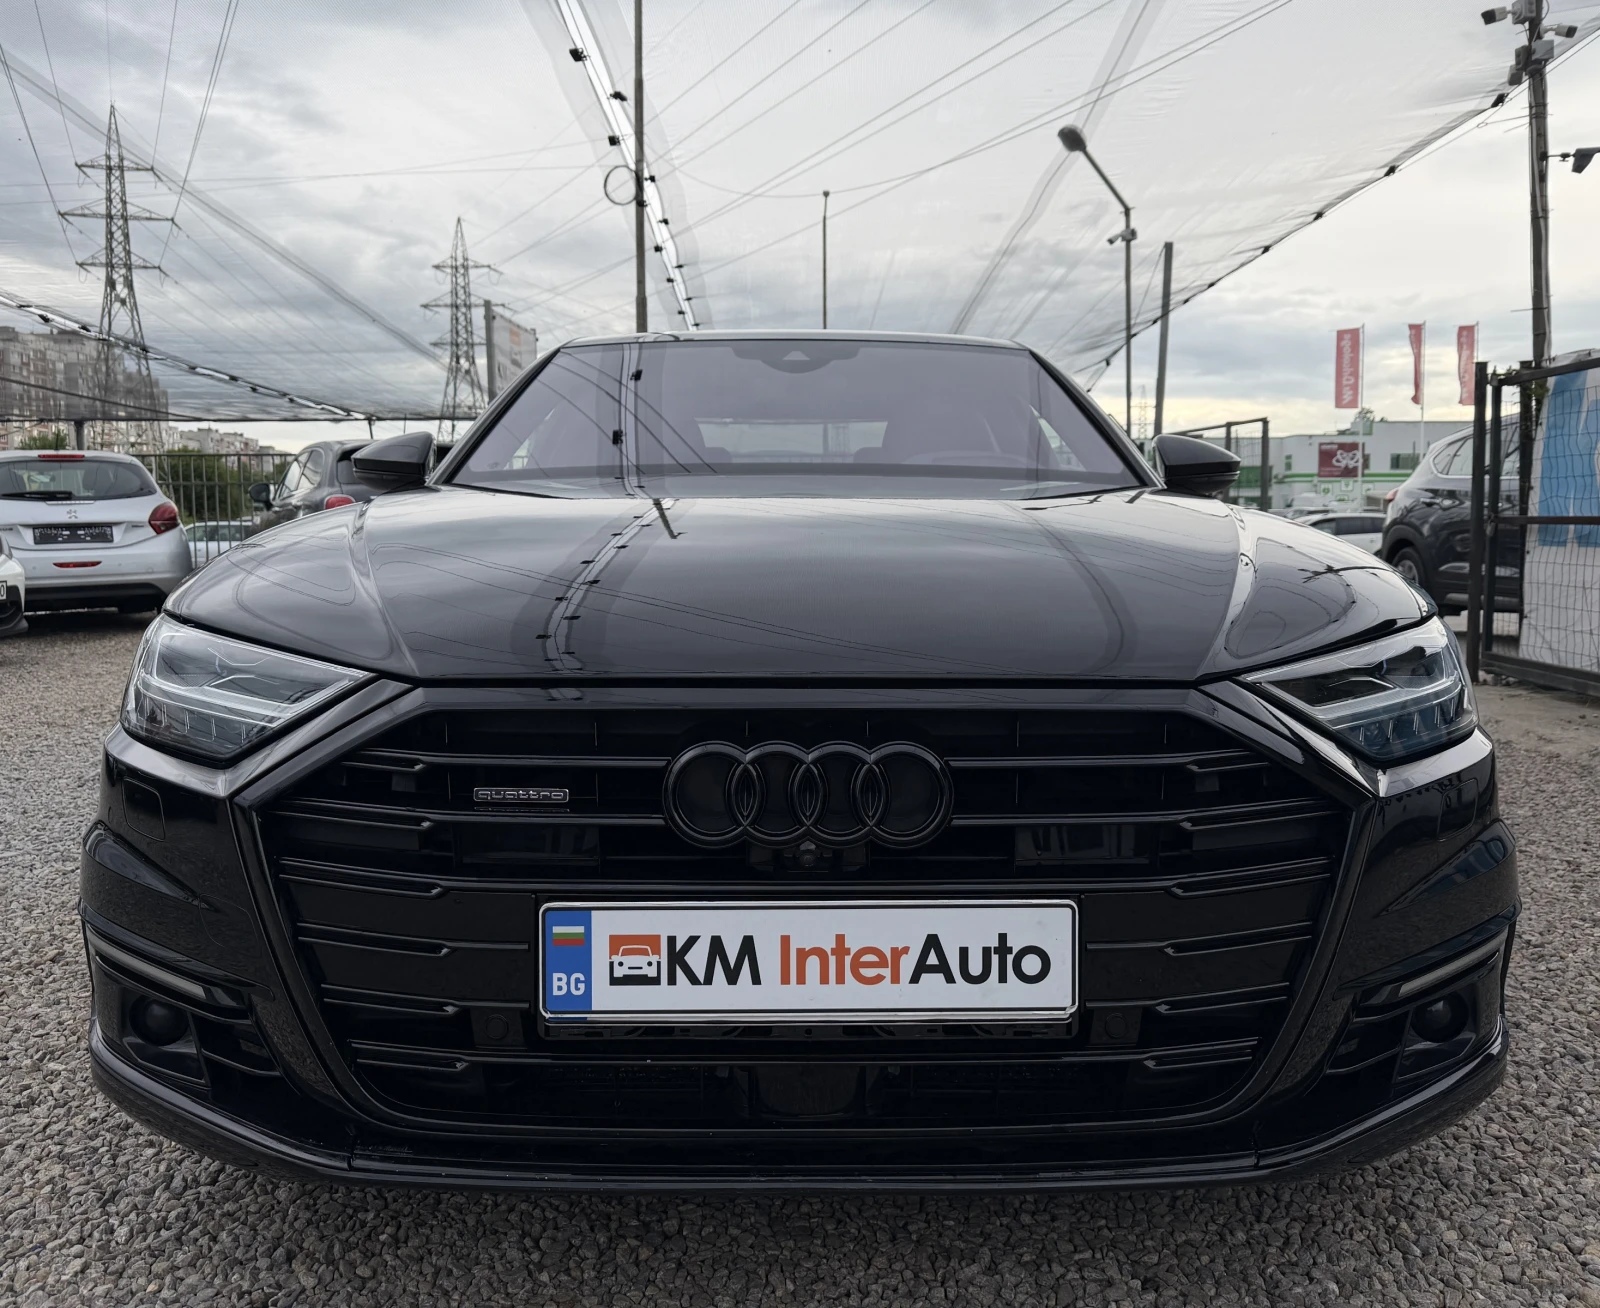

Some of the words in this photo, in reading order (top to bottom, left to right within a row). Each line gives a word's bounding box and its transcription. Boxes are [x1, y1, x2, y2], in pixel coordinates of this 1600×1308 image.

[477, 790, 564, 800] quattro
[666, 935, 762, 986] KM
[780, 932, 1052, 986] InterAuto
[552, 972, 586, 996] BG
